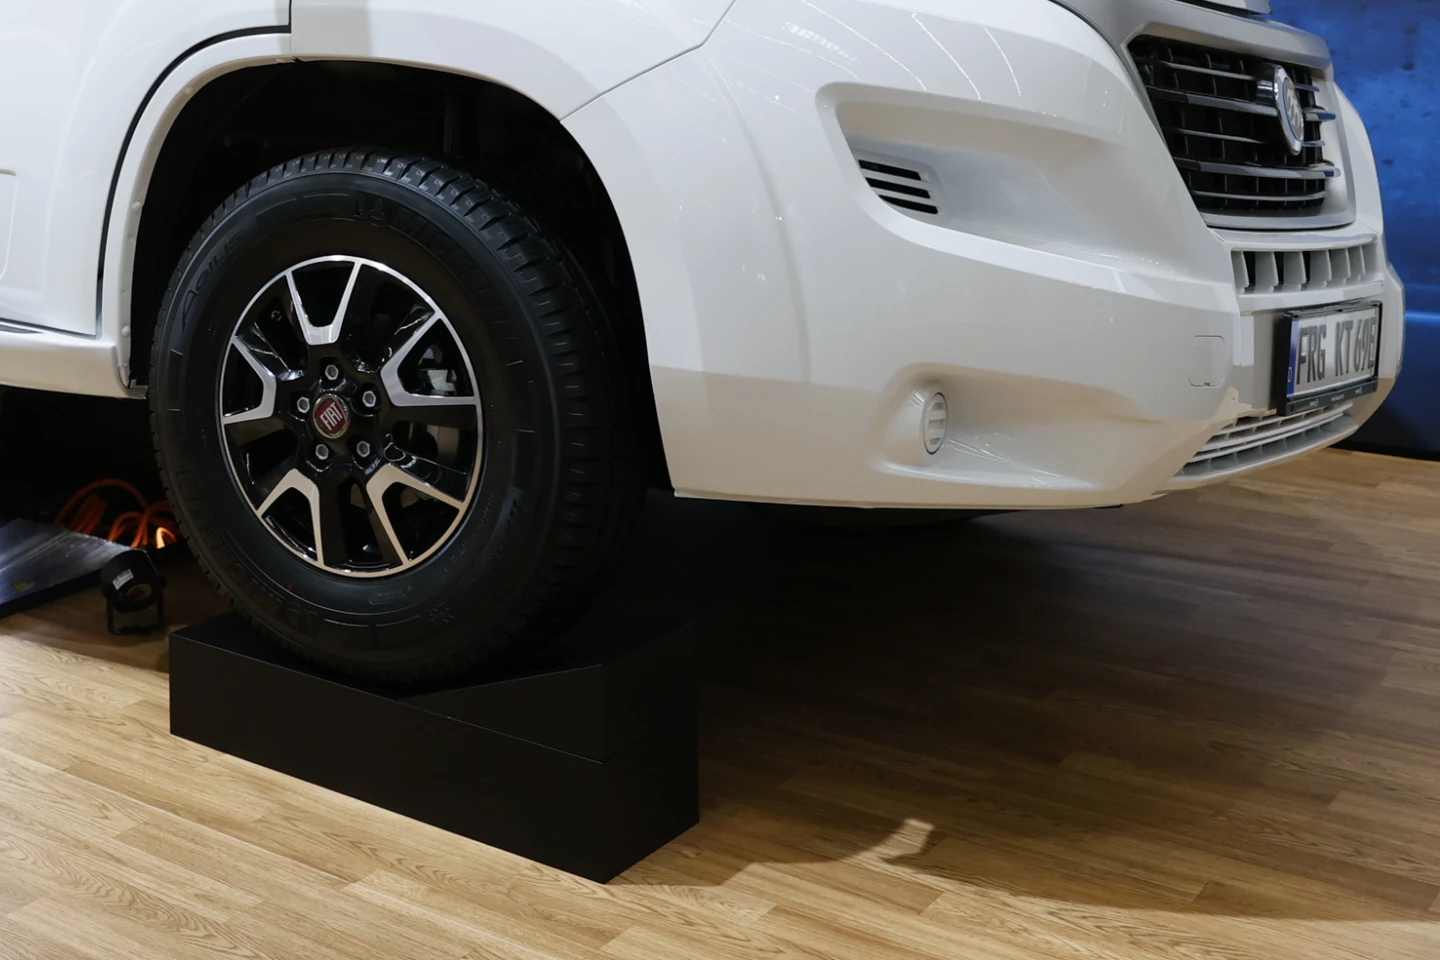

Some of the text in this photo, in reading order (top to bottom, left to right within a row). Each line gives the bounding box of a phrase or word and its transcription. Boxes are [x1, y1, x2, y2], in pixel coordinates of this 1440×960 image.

[1296, 324, 1327, 385] FRG
[1335, 320, 1354, 377] KT
[320, 401, 343, 431] FIAT
